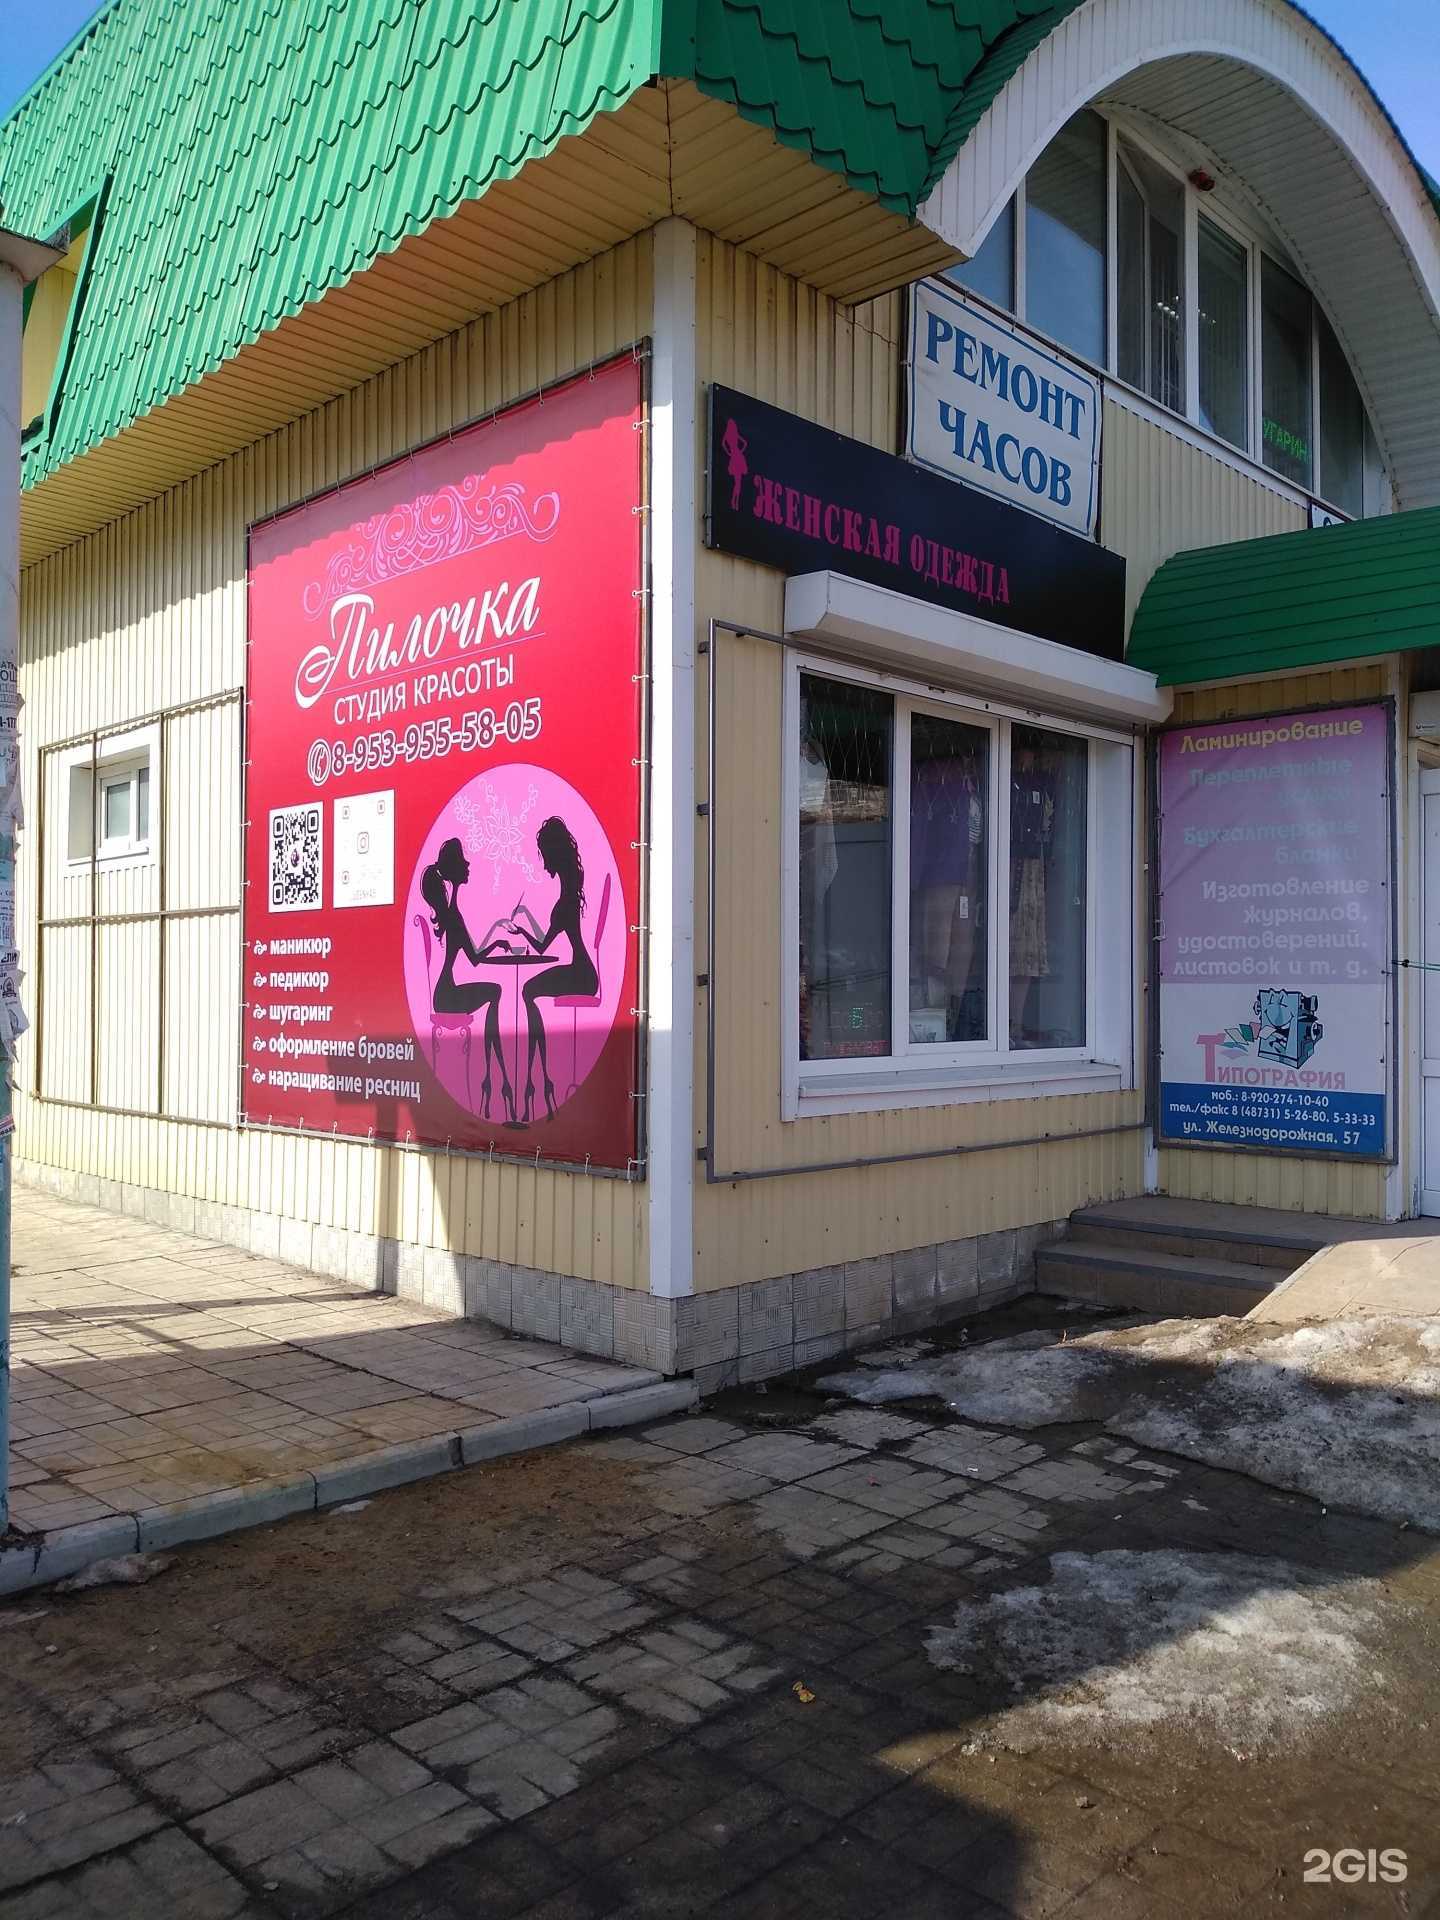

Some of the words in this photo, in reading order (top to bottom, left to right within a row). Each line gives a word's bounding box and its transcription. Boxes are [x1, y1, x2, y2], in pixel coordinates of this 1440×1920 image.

[926, 310, 1086, 440] РЕМОНТ
[938, 400, 1072, 507] ЧАСОВ
[753, 474, 901, 565] ЖЕНСКАЯ
[910, 534, 1010, 607] ОДЕЖДА
[295, 577, 541, 709] Пилочка
[334, 682, 407, 725] СТУДИЯ
[414, 654, 514, 705] КРАСОТЫ
[331, 698, 542, 775] 8-953-955-58-05
[1180, 719, 1363, 754] Ламинирование
[1202, 877, 1369, 902] Изготовление
[269, 935, 331, 958] маникюр
[269, 970, 329, 992] педикюр
[1173, 956, 1280, 976] листовок
[1289, 961, 1300, 975] и
[1348, 959, 1368, 979] д.
[269, 1003, 332, 1026] шугаринг
[269, 1033, 355, 1058] оформление
[358, 1035, 414, 1062] бровей
[268, 1069, 362, 1094] наращивание
[365, 1077, 420, 1102] ресниц
[1241, 1091, 1329, 1108] 8-920-274-10-40
[1169, 1102, 1229, 1116] тел./факс
[1231, 1105, 1238, 1116] 8
[1241, 1106, 1280, 1120] (48731)
[1333, 1112, 1376, 1126] 5-33-33
[1183, 1122, 1201, 1134] ул.
[1343, 1131, 1360, 1145] 57
